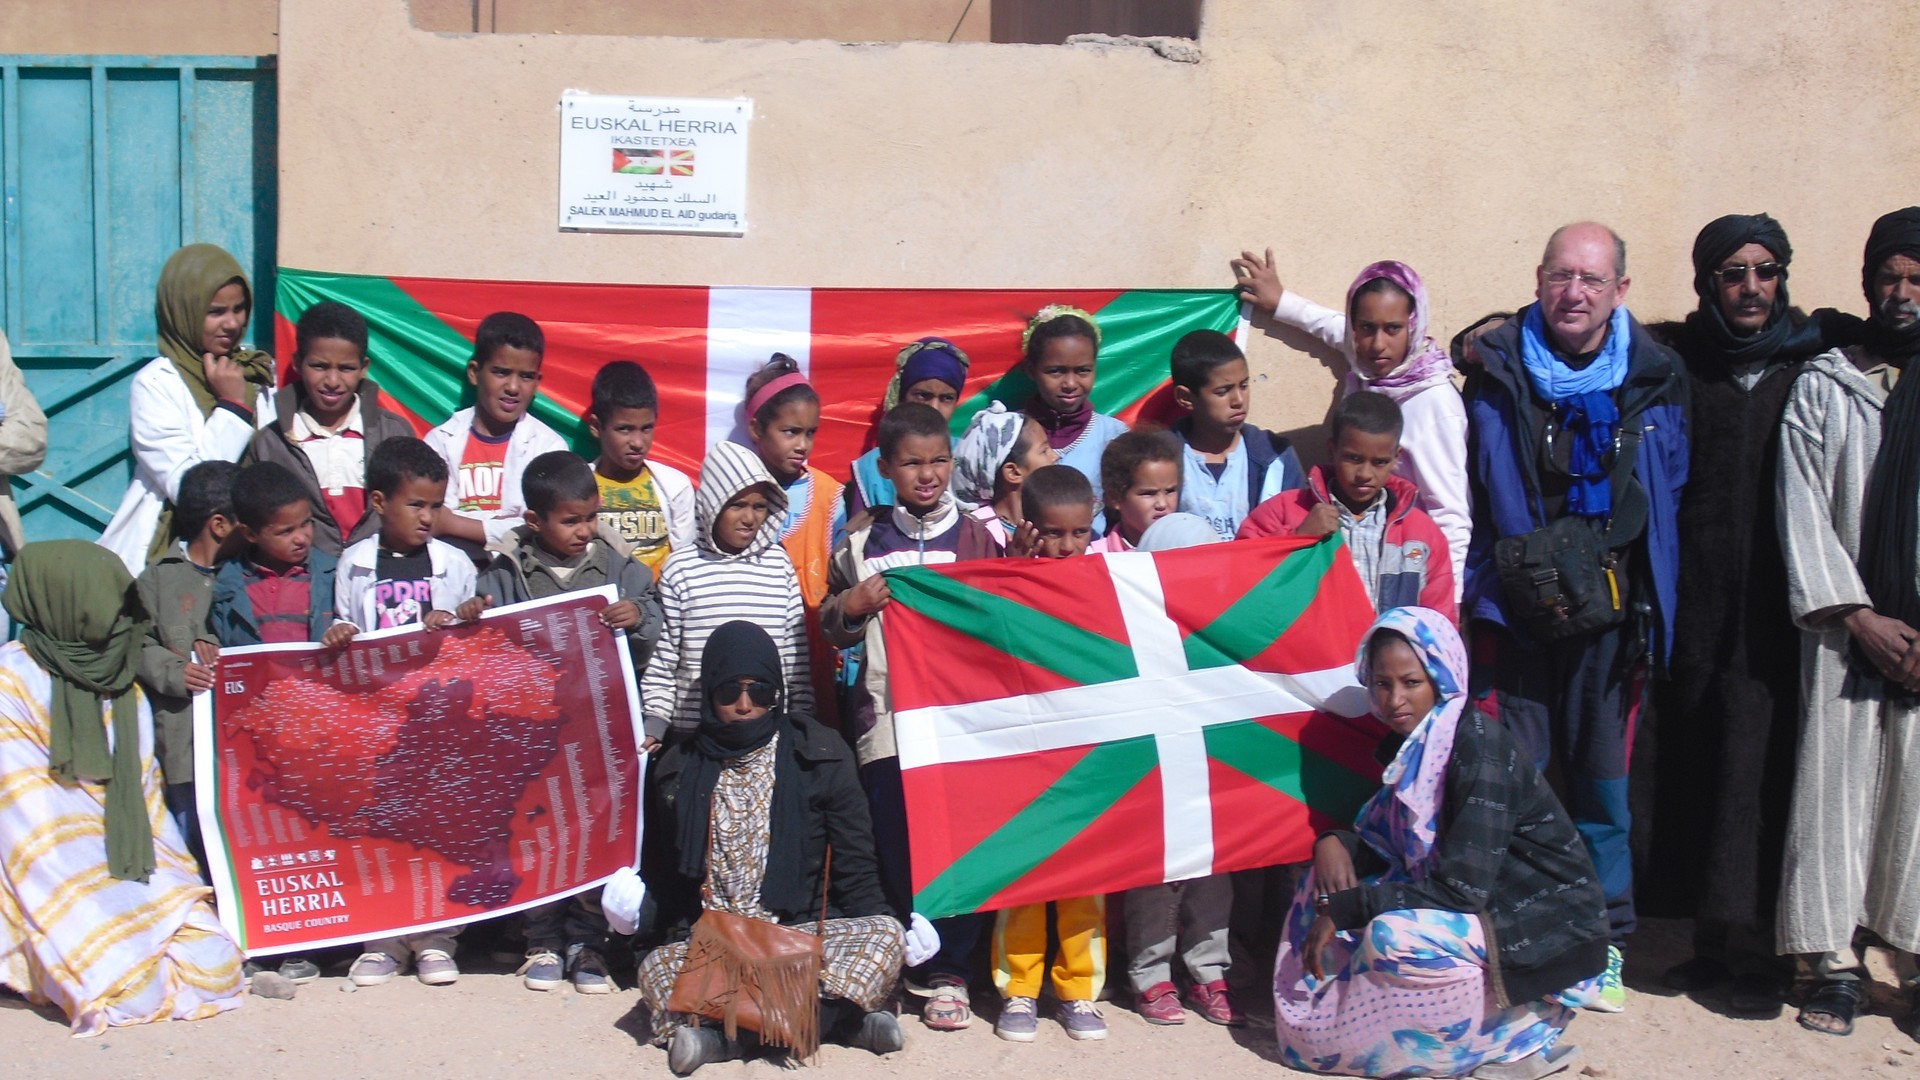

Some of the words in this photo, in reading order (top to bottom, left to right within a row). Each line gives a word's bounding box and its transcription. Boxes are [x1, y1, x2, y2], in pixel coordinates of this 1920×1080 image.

[628, 100, 681, 117] مدرسة
[571, 116, 653, 132] EUSKAL
[659, 119, 738, 134] HERRIA
[610, 135, 697, 147] IKASTETXEA
[634, 179, 674, 192] شهيد
[569, 205, 606, 216] SALEK
[608, 207, 659, 218] MAHMUD
[661, 208, 675, 218] EL
[677, 209, 696, 219] AID
[698, 211, 737, 222] gudaria
[224, 680, 246, 695] EUS
[255, 871, 344, 896] EUSKAL
[261, 890, 346, 916] HERRIA
[263, 920, 302, 933] BASQUE
[304, 914, 350, 928] COUNTRY
